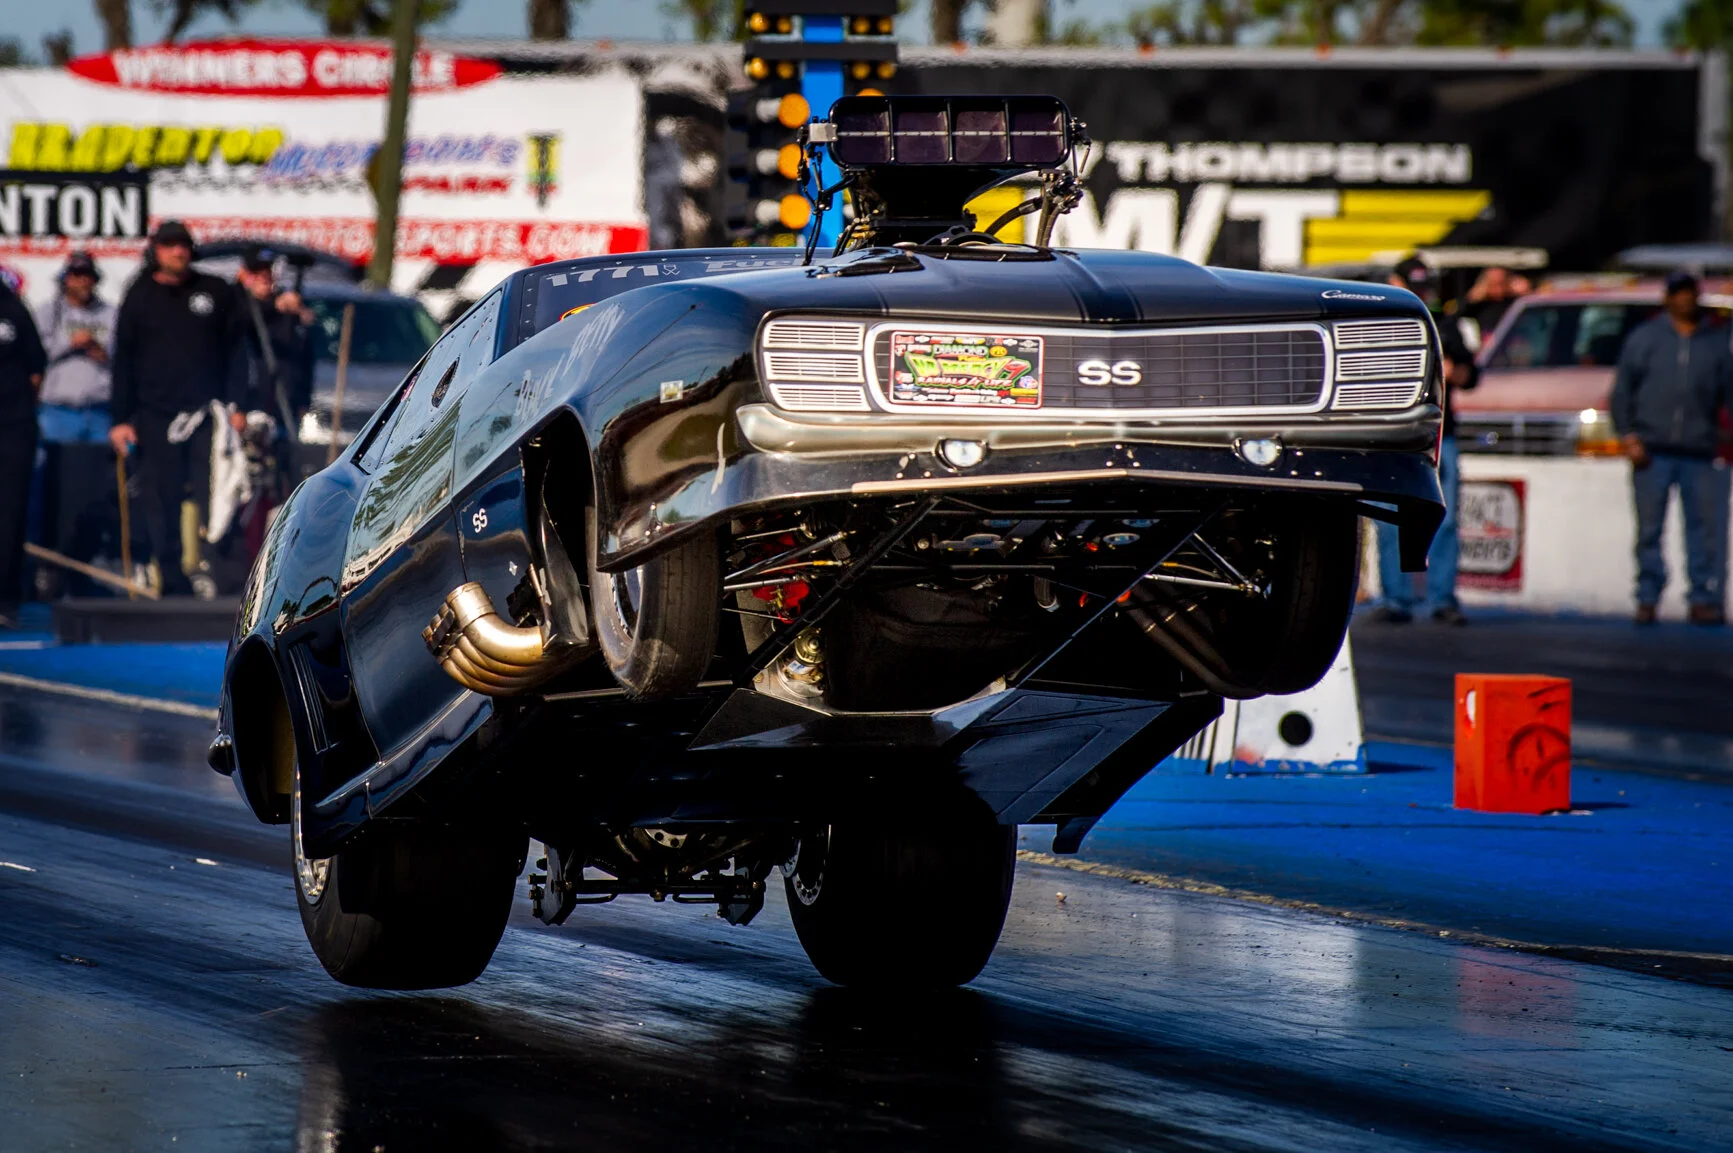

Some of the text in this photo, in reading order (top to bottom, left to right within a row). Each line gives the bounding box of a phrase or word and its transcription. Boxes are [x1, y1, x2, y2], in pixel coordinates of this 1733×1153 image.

[112, 50, 307, 88] WINNERS
[1106, 141, 1473, 184] THOMPSON
[546, 264, 659, 287] 1771
[1321, 289, 1386, 301] Camaro
[1078, 359, 1142, 386] SS
[472, 507, 488, 533] SS
